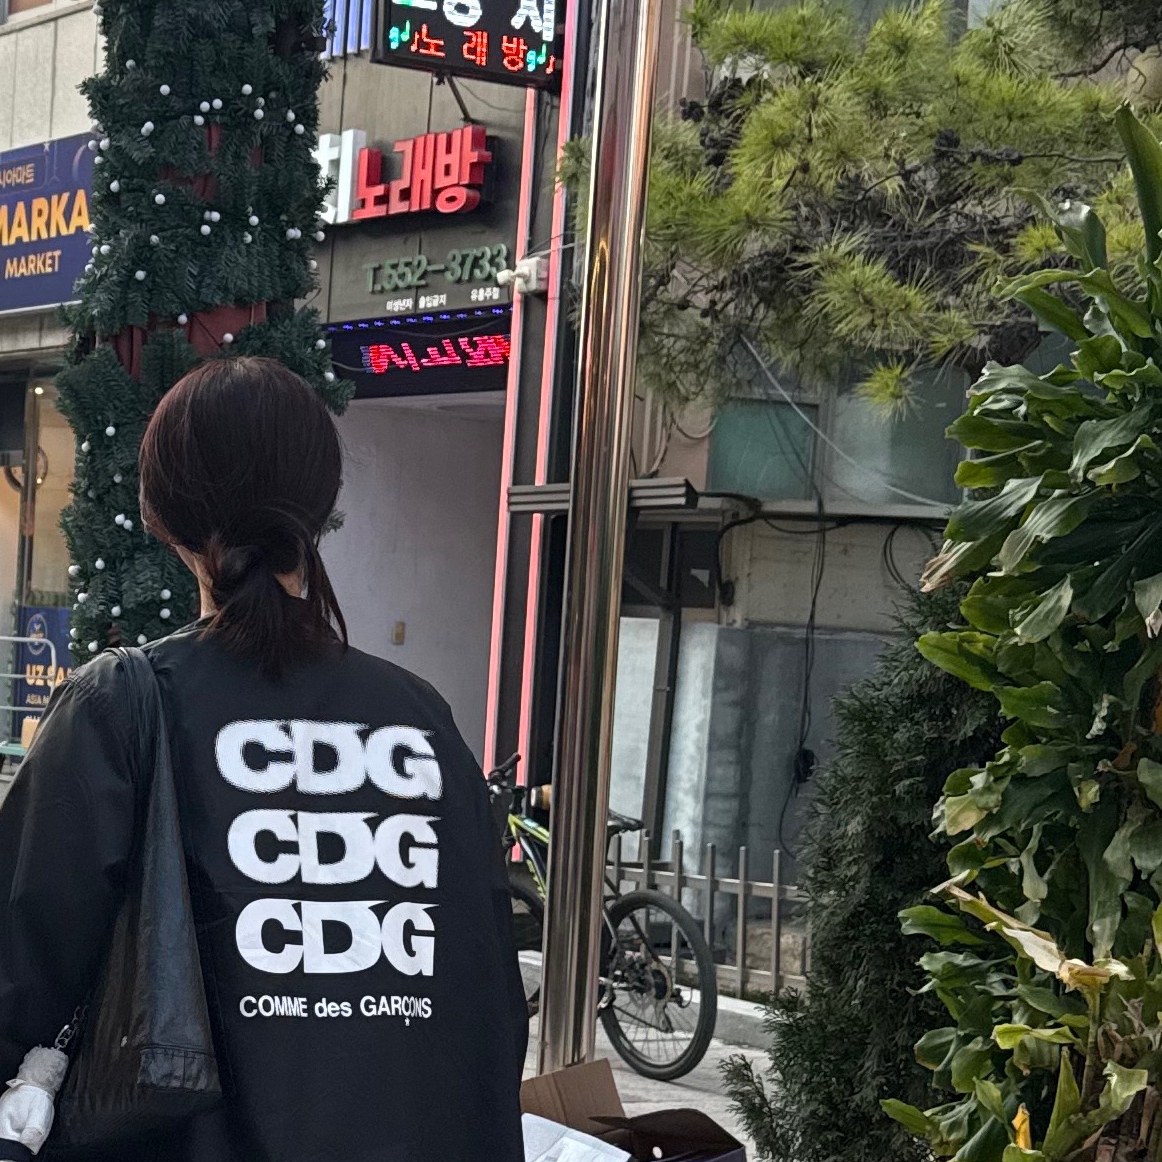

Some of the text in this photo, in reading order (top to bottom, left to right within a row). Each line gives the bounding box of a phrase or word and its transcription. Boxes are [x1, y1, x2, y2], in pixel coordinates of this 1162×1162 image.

[351, 125, 492, 219] 노래방
[5, 249, 62, 280] MARKET
[26, 664, 44, 686] UZ
[215, 718, 443, 800] CDG
[227, 808, 441, 889] CDG
[236, 898, 439, 977] CDG
[240, 995, 309, 1018] COMME
[314, 996, 352, 1018] des
